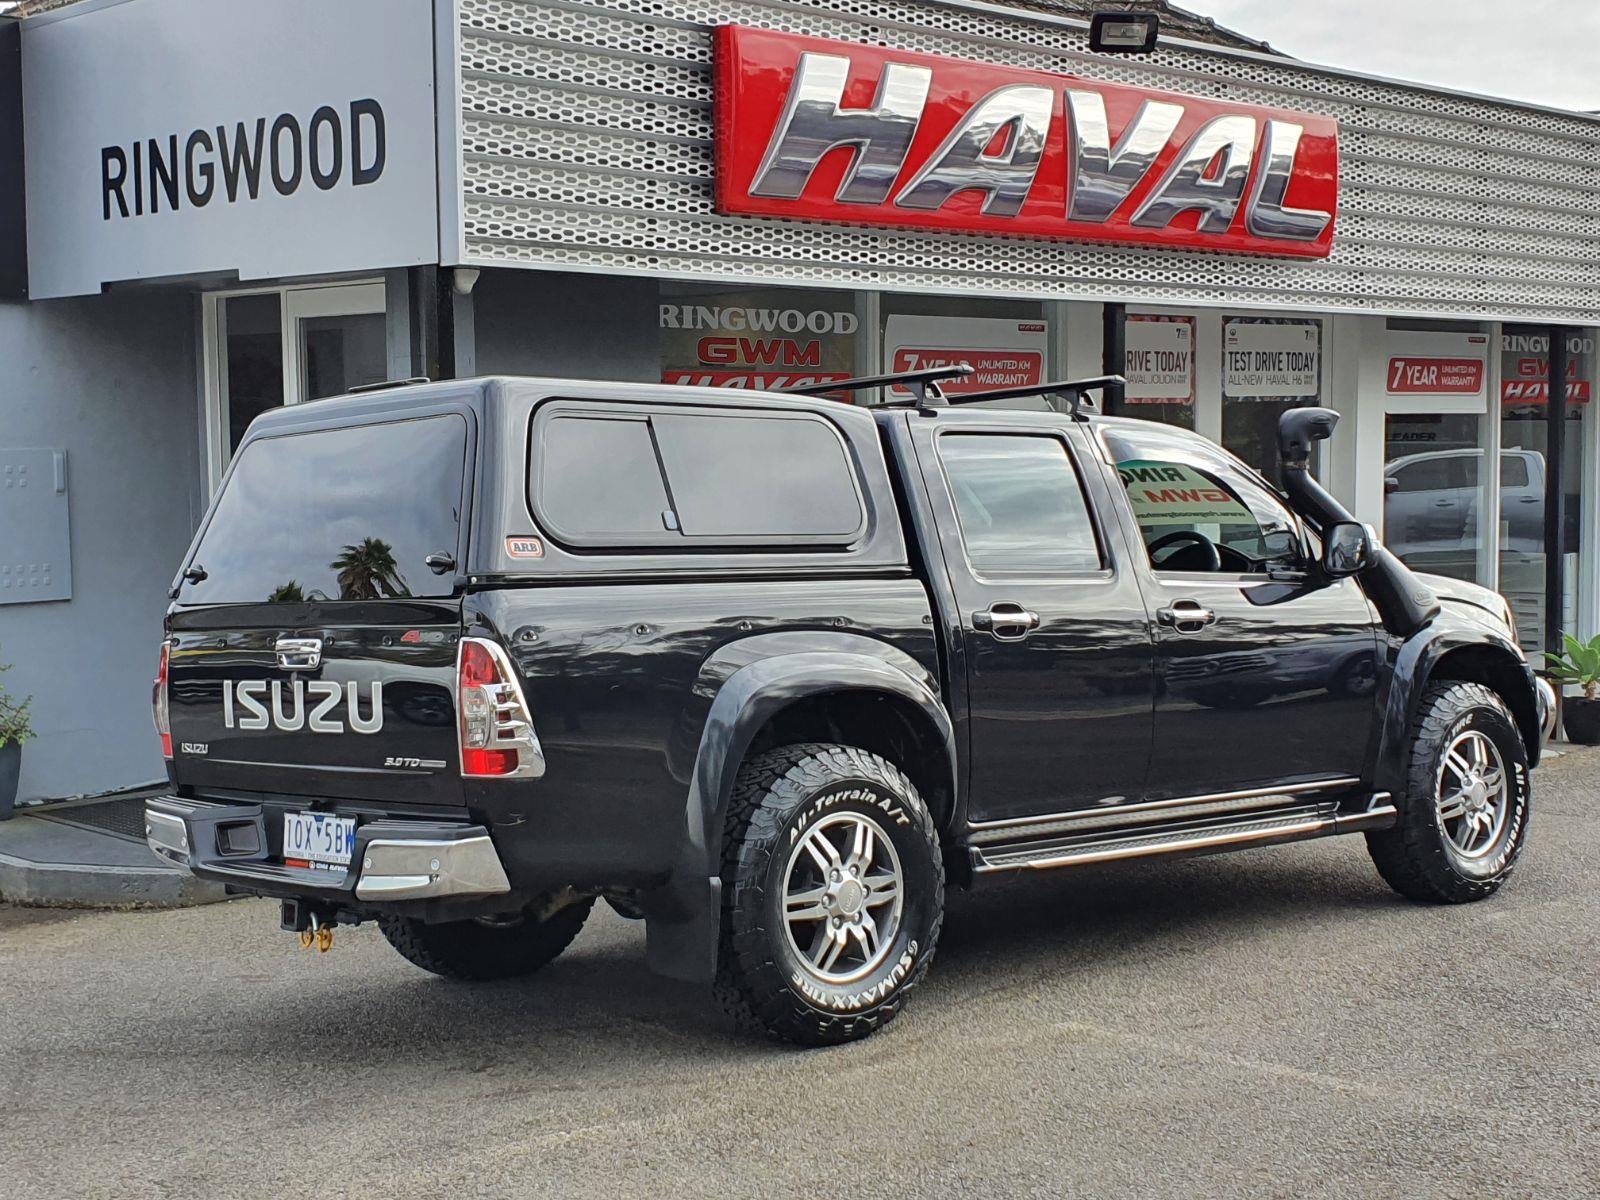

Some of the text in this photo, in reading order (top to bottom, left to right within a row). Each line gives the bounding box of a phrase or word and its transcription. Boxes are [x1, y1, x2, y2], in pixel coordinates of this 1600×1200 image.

[748, 51, 1331, 242] HAVAL
[101, 98, 386, 220] RINGWOOD
[659, 304, 859, 334] RINGWOOD
[697, 336, 821, 367] GWM
[1501, 335, 1594, 354] RINGOD
[977, 359, 1031, 370] UNLIMITED KM
[1126, 351, 1188, 372] RIVE TODAY
[1228, 351, 1315, 372] TEST DRIVE TODAY
[977, 373, 1030, 385] WARRANTY
[1228, 374, 1263, 385] ALL-NEW
[1265, 374, 1290, 385] HAVAL
[1292, 375, 1302, 385] H6
[1392, 361, 1437, 388] 7 YEAR
[1441, 376, 1475, 386] WARRANTY
[513, 542, 538, 552] ARB
[223, 679, 384, 734] ISUZU
[181, 742, 208, 754] ISUZU
[790, 788, 910, 846] All-Terrain A/T
[1504, 762, 1525, 854] All-Terrain
[791, 950, 913, 1010] SUMAXX TIRE
